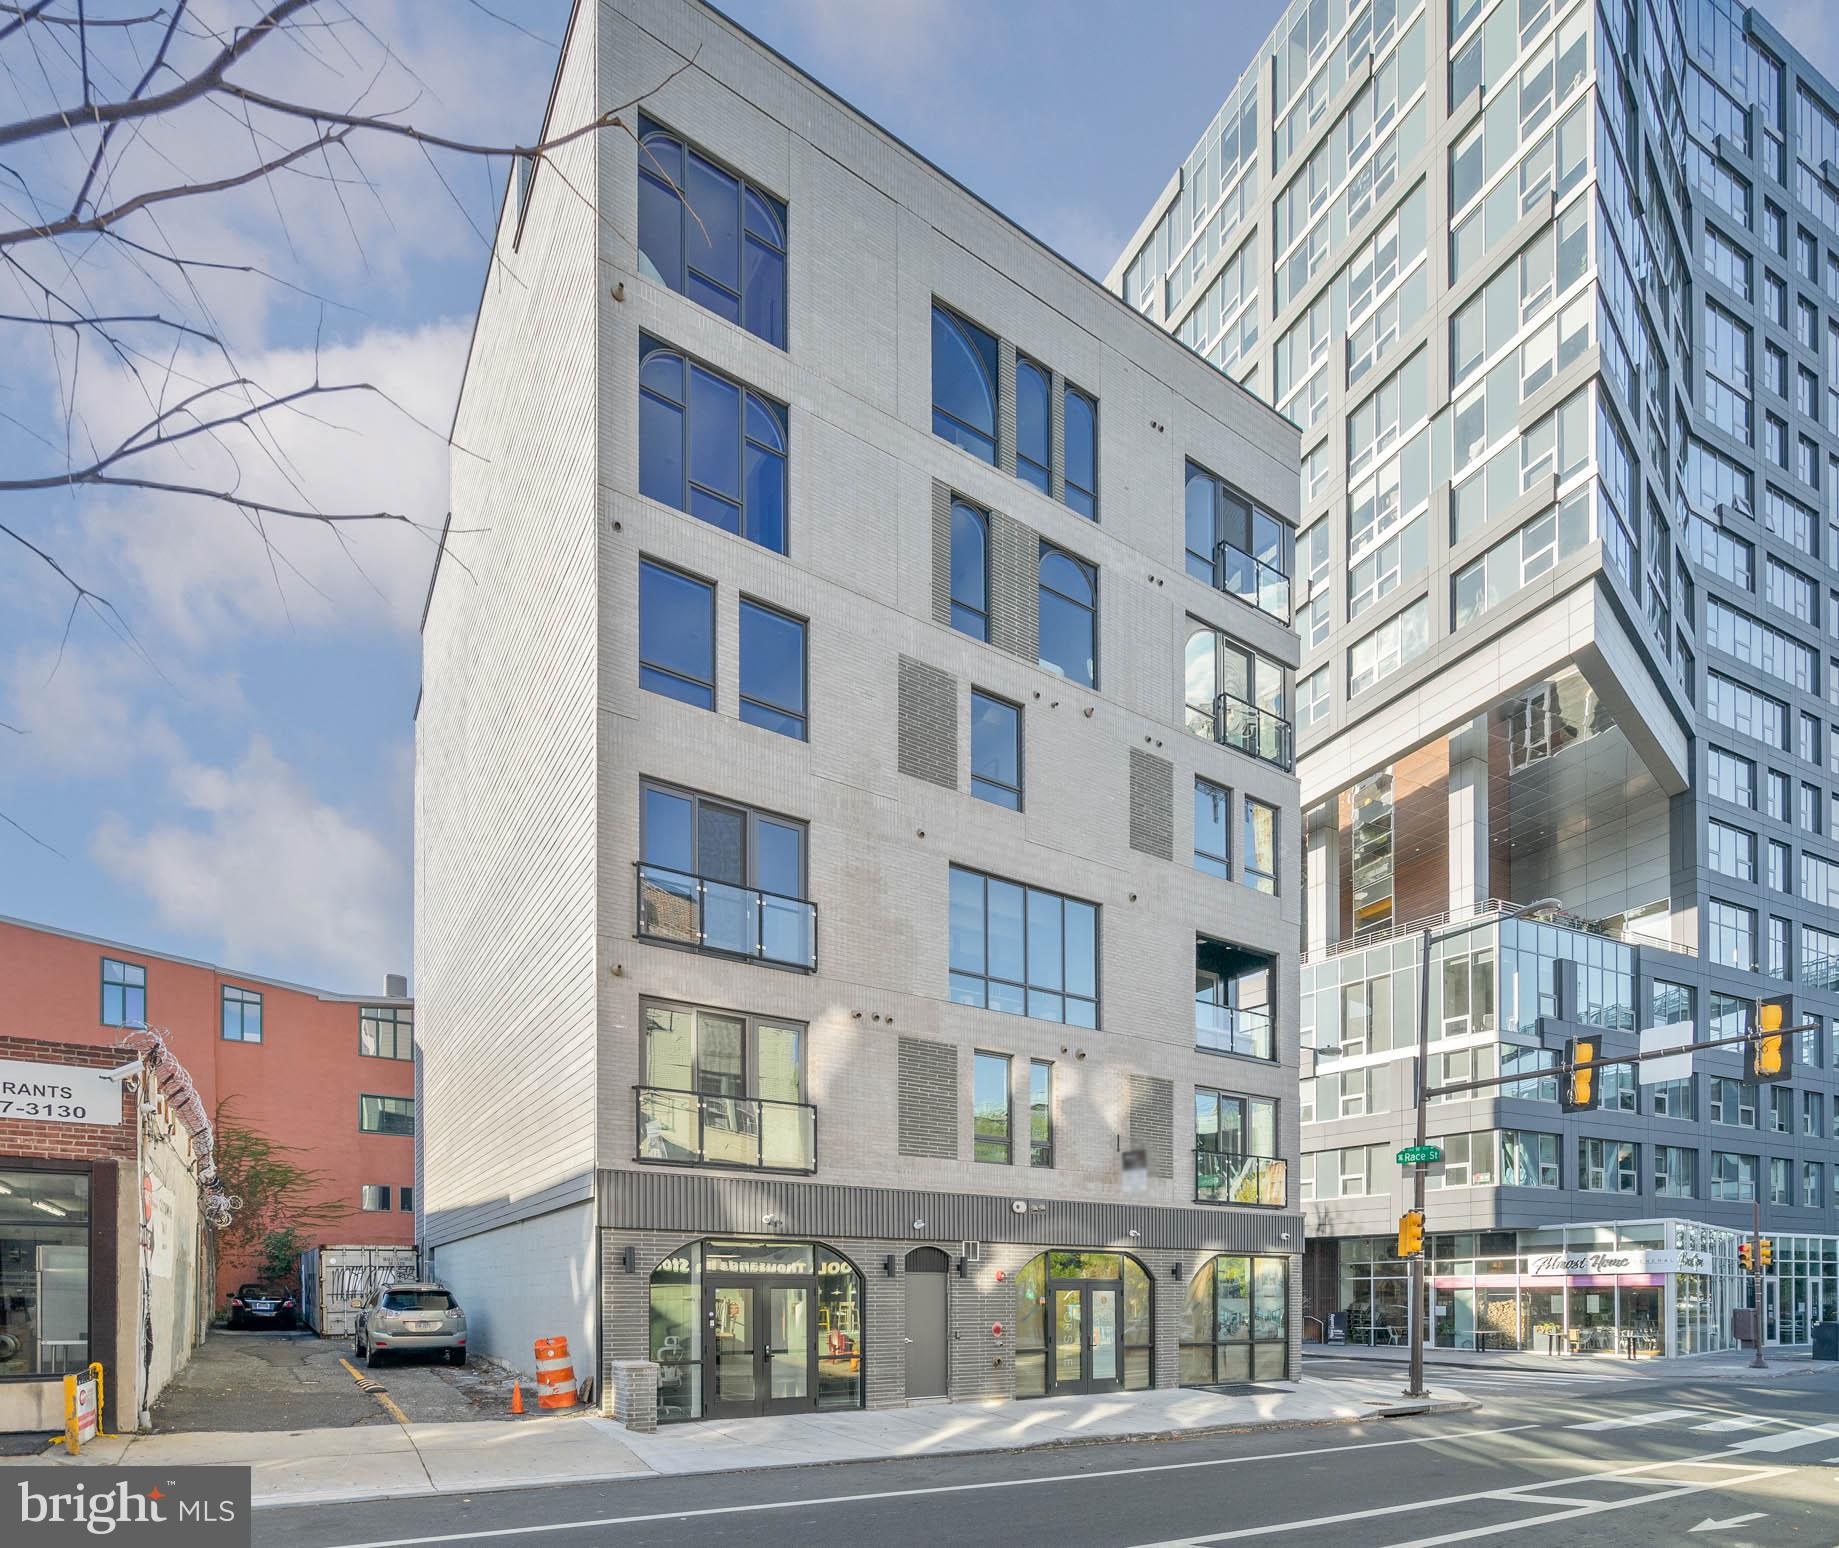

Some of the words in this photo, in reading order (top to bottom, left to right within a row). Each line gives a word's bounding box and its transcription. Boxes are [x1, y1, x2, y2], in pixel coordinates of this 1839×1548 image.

[2, 1081, 73, 1099] RANTS
[0, 1100, 87, 1119] 7-3130
[1404, 1152, 1426, 1162] Race
[1429, 1151, 1438, 1160] St
[1533, 1254, 1586, 1274] Almost
[1589, 1253, 1630, 1273] Home
